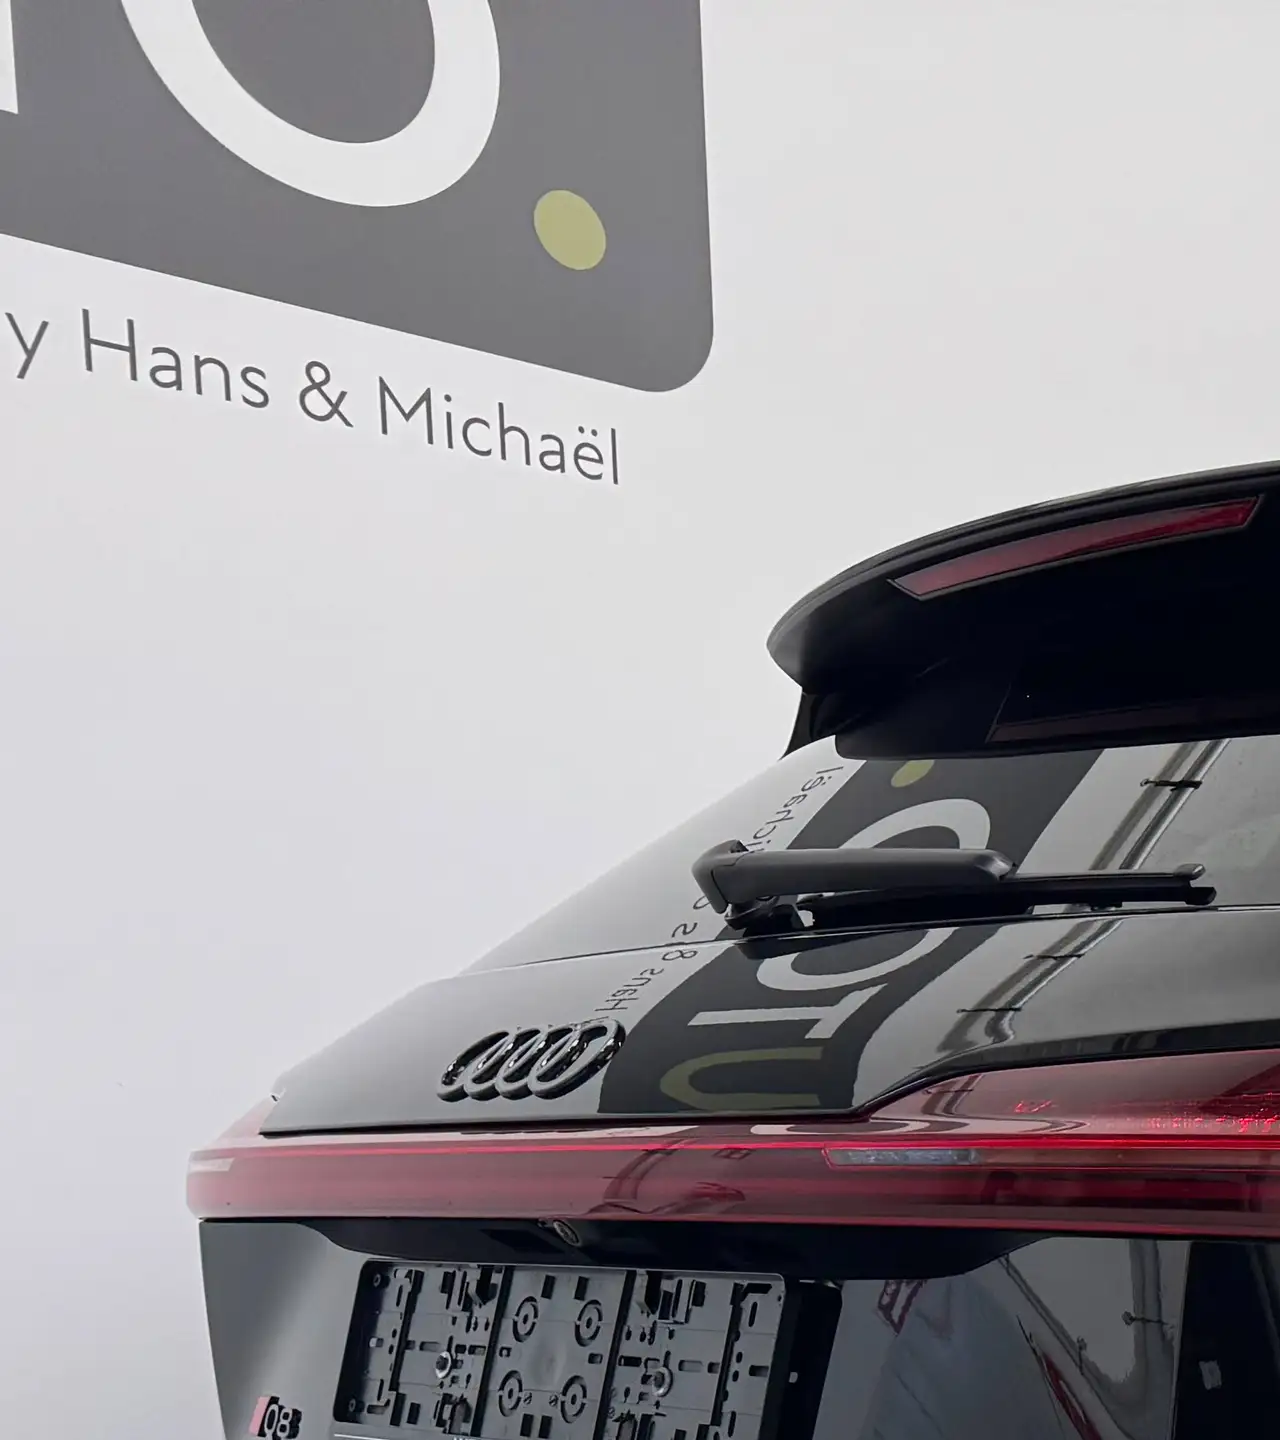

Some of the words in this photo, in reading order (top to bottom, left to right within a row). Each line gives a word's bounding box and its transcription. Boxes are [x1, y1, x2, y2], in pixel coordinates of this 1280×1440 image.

[81, 308, 271, 408] Hans
[298, 360, 354, 428] &
[378, 375, 620, 486] Michaël
